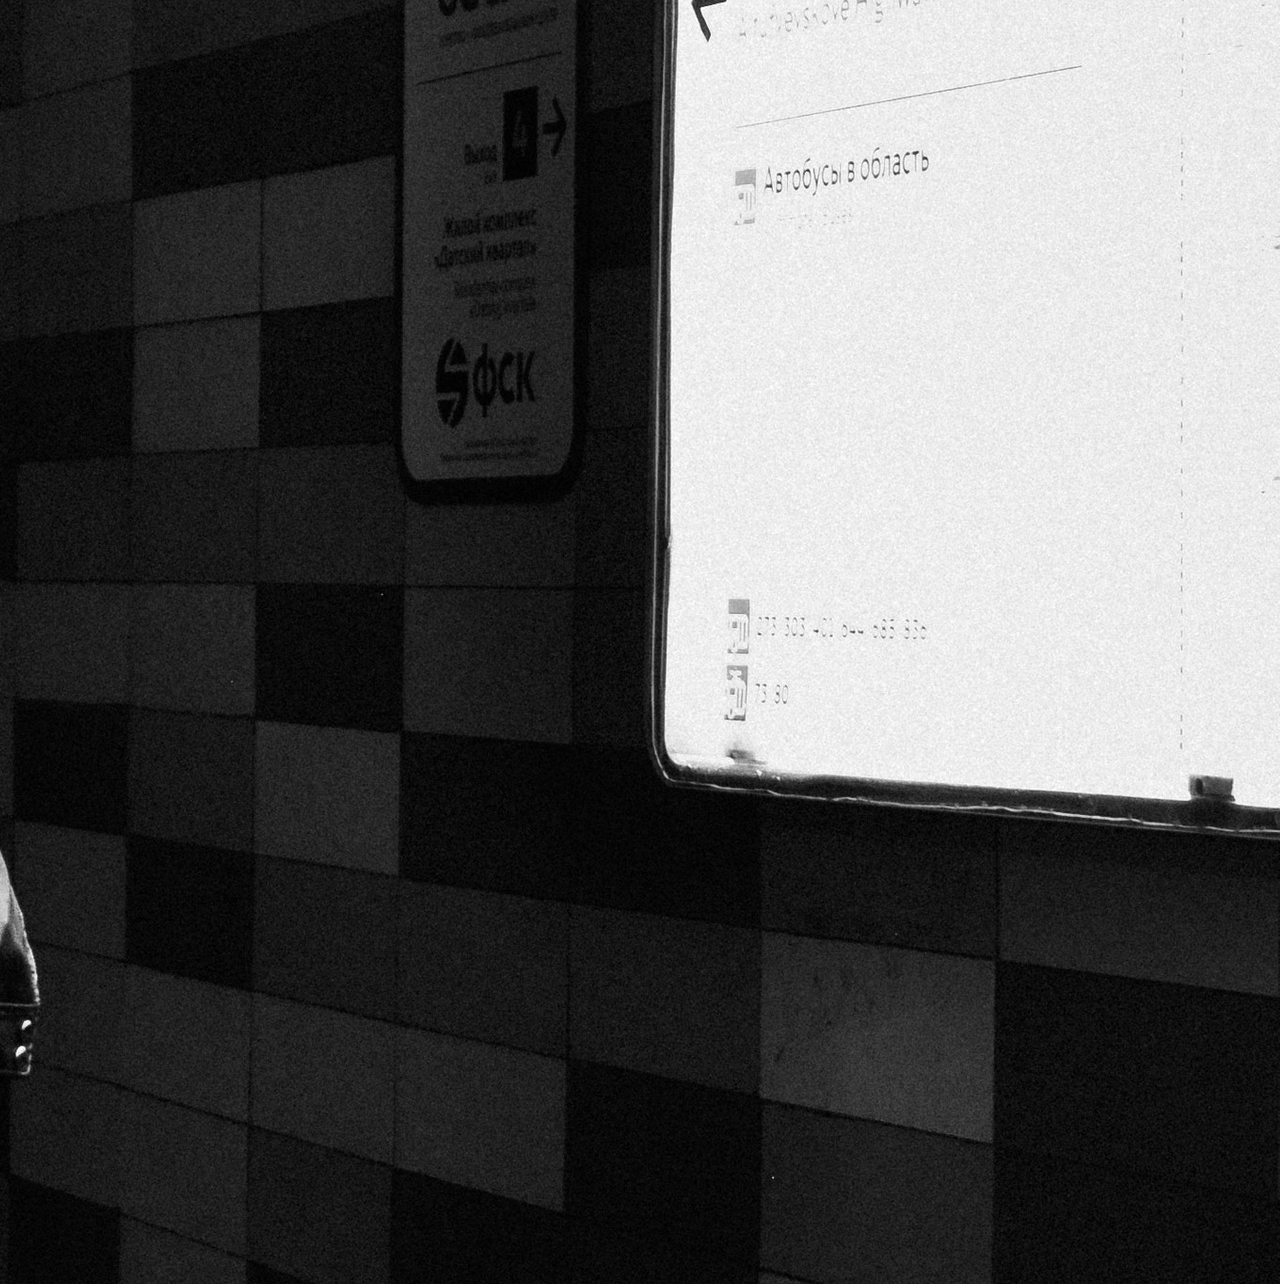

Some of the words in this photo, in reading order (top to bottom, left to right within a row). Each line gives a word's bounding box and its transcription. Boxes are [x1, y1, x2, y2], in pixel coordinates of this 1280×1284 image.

[763, 157, 843, 197] Автобусы
[847, 159, 856, 183] в
[860, 146, 931, 182] область
